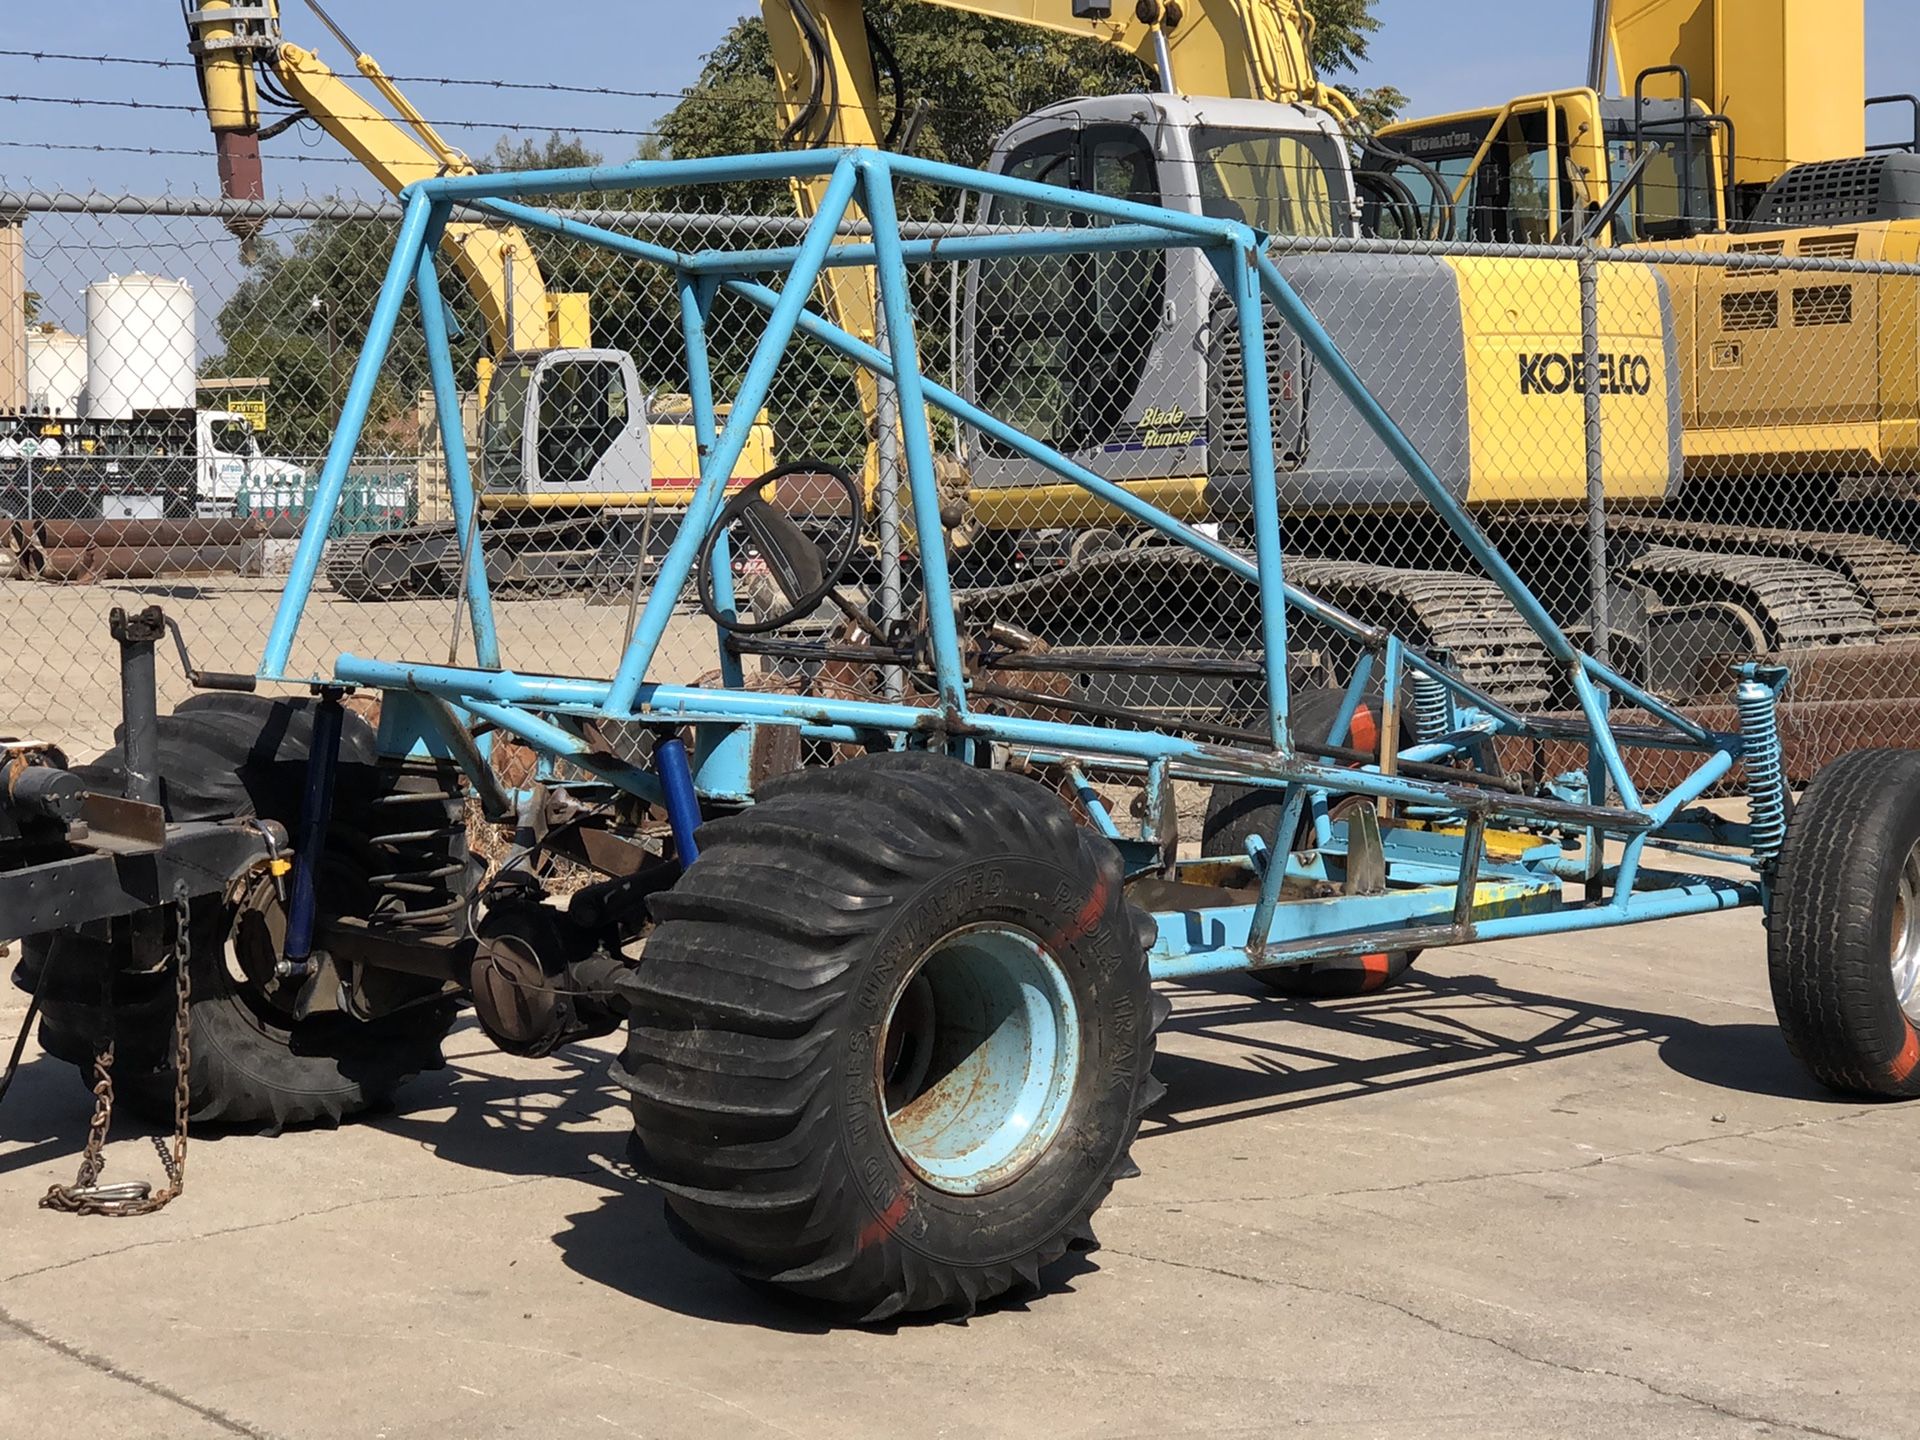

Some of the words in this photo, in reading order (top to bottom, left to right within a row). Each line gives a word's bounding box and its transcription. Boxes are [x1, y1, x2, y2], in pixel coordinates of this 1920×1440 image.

[1411, 131, 1471, 152] KOMATSU
[1518, 352, 1651, 396] KOBELCO
[1138, 404, 1184, 427] Blade
[1142, 429, 1197, 447] Runner
